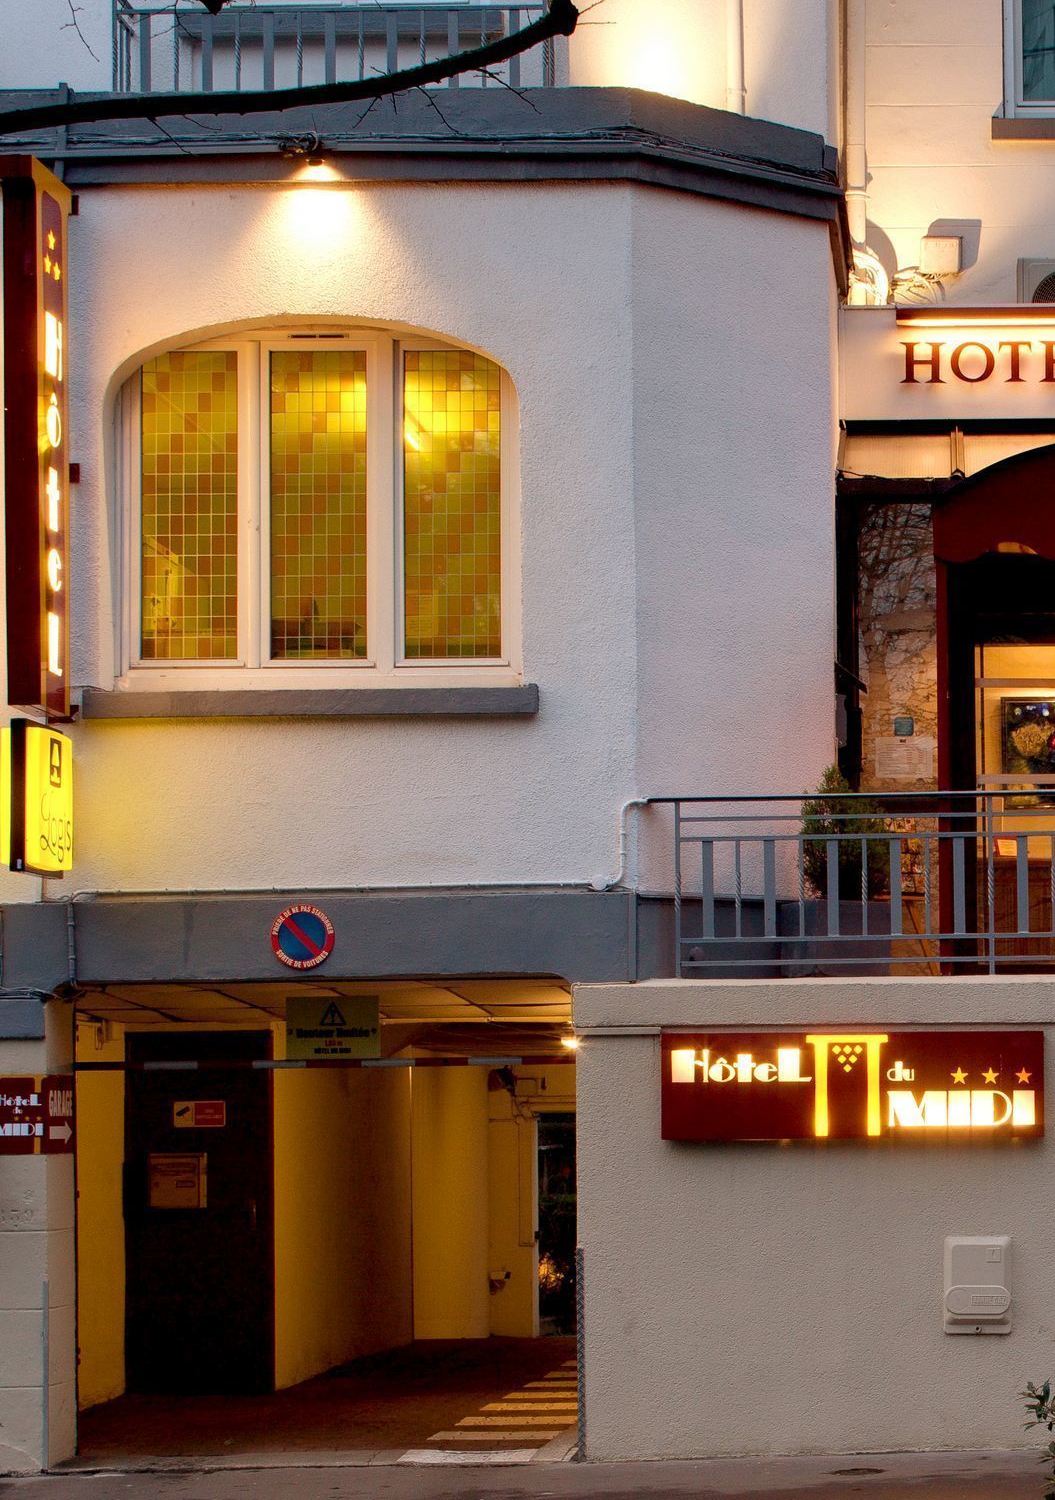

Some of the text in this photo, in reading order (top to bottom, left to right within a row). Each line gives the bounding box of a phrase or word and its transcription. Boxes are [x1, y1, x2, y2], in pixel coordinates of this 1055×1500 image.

[40, 792, 71, 863] Logis
[283, 909, 292, 918] DE
[293, 960, 301, 968] DE
[302, 950, 329, 968] VOITURES
[886, 1061, 915, 1081] du
[48, 1090, 73, 1117] GARAGE
[887, 1090, 1036, 1127] MIDI
